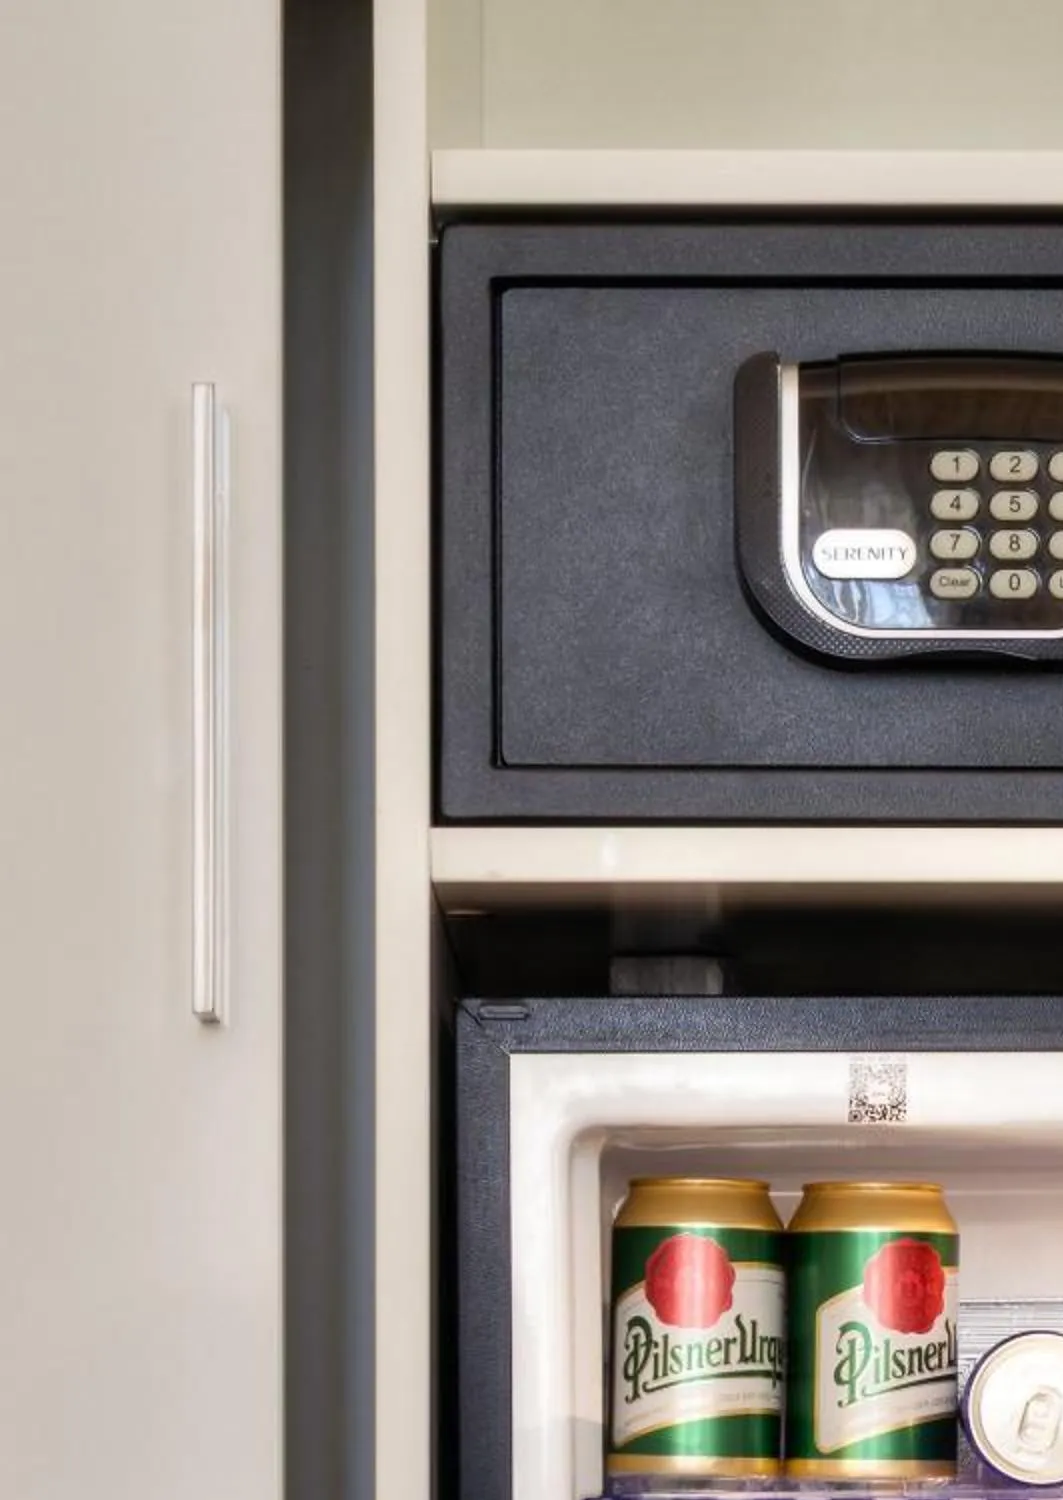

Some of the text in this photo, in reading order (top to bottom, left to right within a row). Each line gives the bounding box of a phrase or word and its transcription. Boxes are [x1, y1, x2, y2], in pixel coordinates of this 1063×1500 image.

[952, 457, 961, 473] 1
[1009, 457, 1021, 473] 2
[949, 495, 961, 512] 4
[1009, 495, 1021, 512] 5
[950, 535, 961, 551] 7
[1009, 535, 1021, 551] 8
[821, 547, 908, 561] SERENITY
[939, 575, 971, 587] Clear
[1009, 574, 1021, 591] 0
[623, 1315, 737, 1404] Pilsner
[833, 1320, 947, 1409] Pilsner
